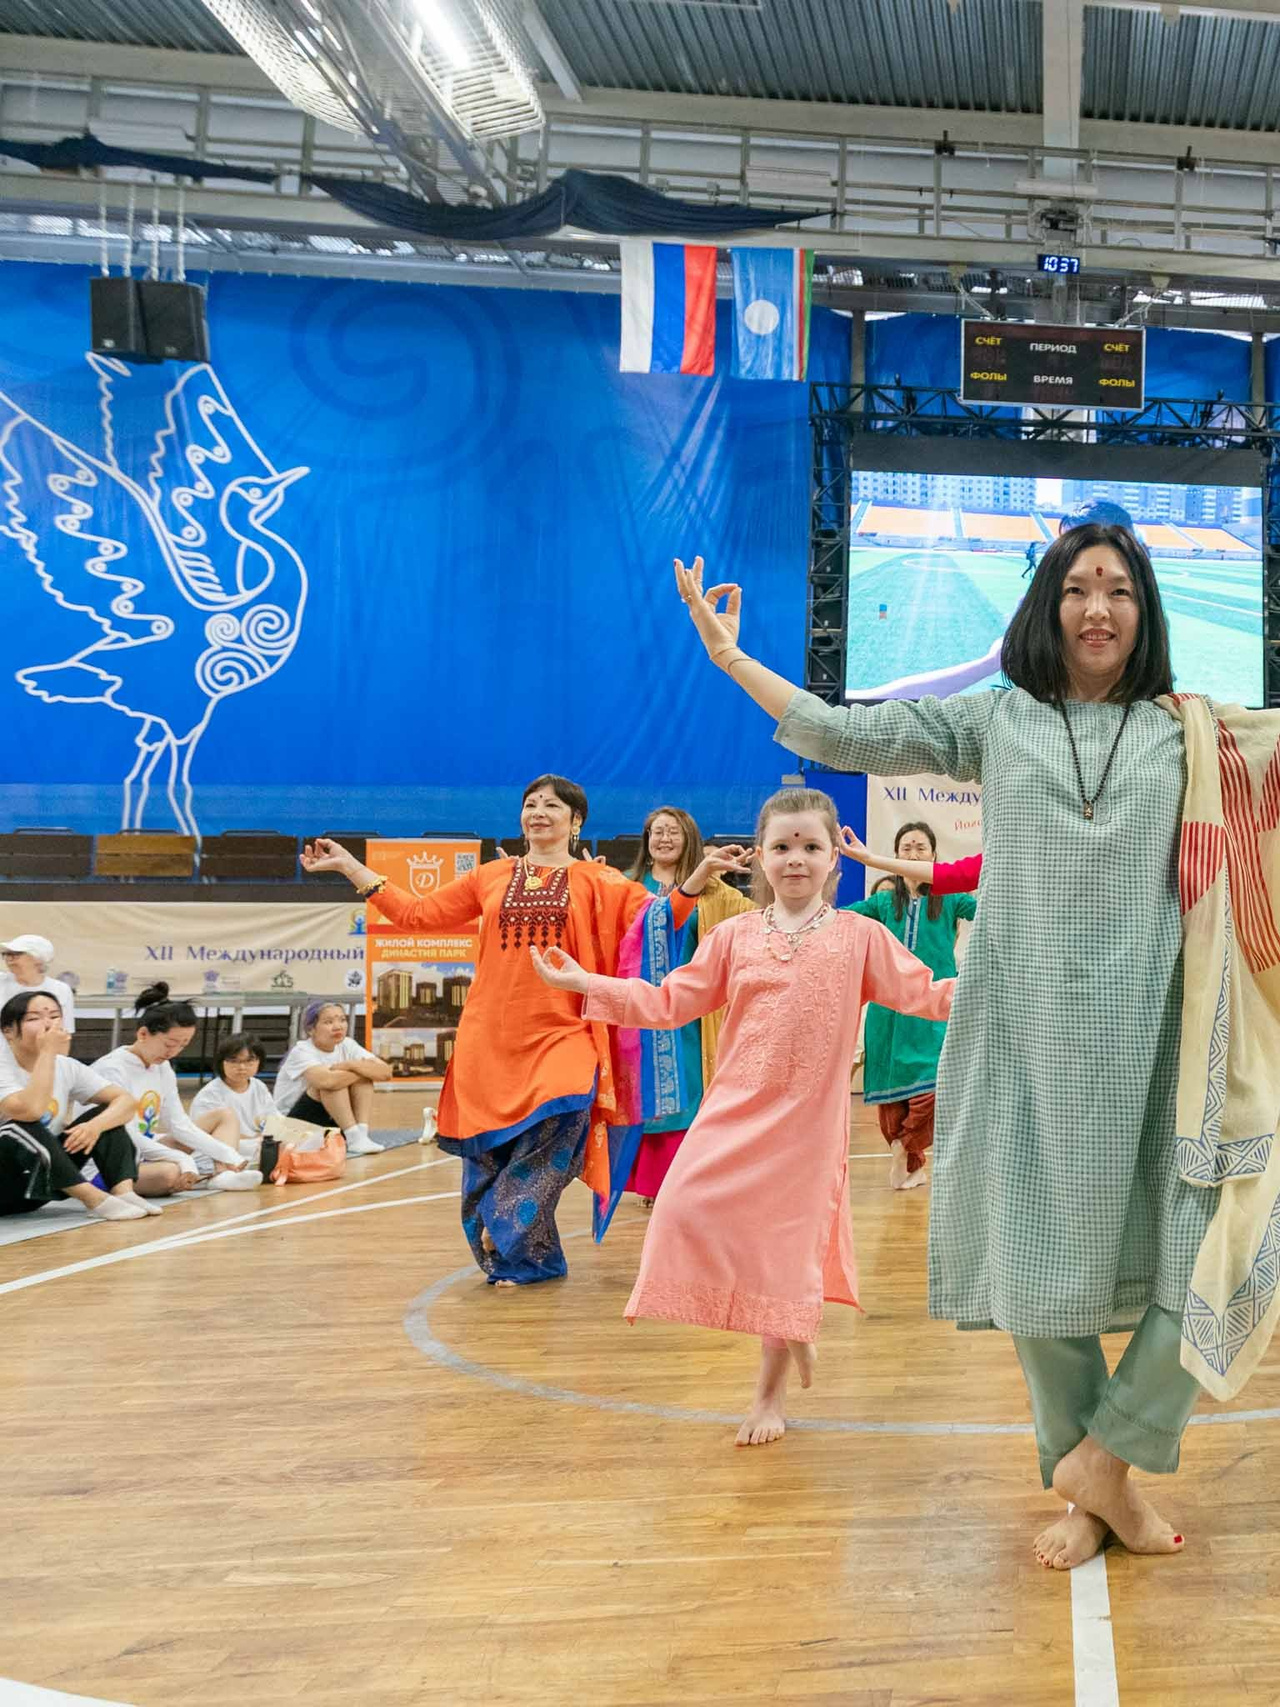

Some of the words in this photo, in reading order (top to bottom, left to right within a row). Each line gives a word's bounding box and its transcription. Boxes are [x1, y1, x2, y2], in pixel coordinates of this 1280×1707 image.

[1029, 342, 1078, 354] ПЕРИОД
[970, 371, 1008, 381] ФОЛЫ
[1033, 374, 1074, 385] ВРЕМЯ
[1098, 377, 1136, 388] ФОЛЫ
[883, 786, 907, 801] XII
[918, 787, 982, 806] Между
[375, 936, 414, 948] ЖИЛОЙ
[417, 939, 473, 948] КОМПЛЕКС
[145, 946, 173, 961] XII
[187, 946, 365, 964] Международный
[381, 949, 437, 959] ДИНАСТИЯ
[439, 949, 467, 958] ПАРК
